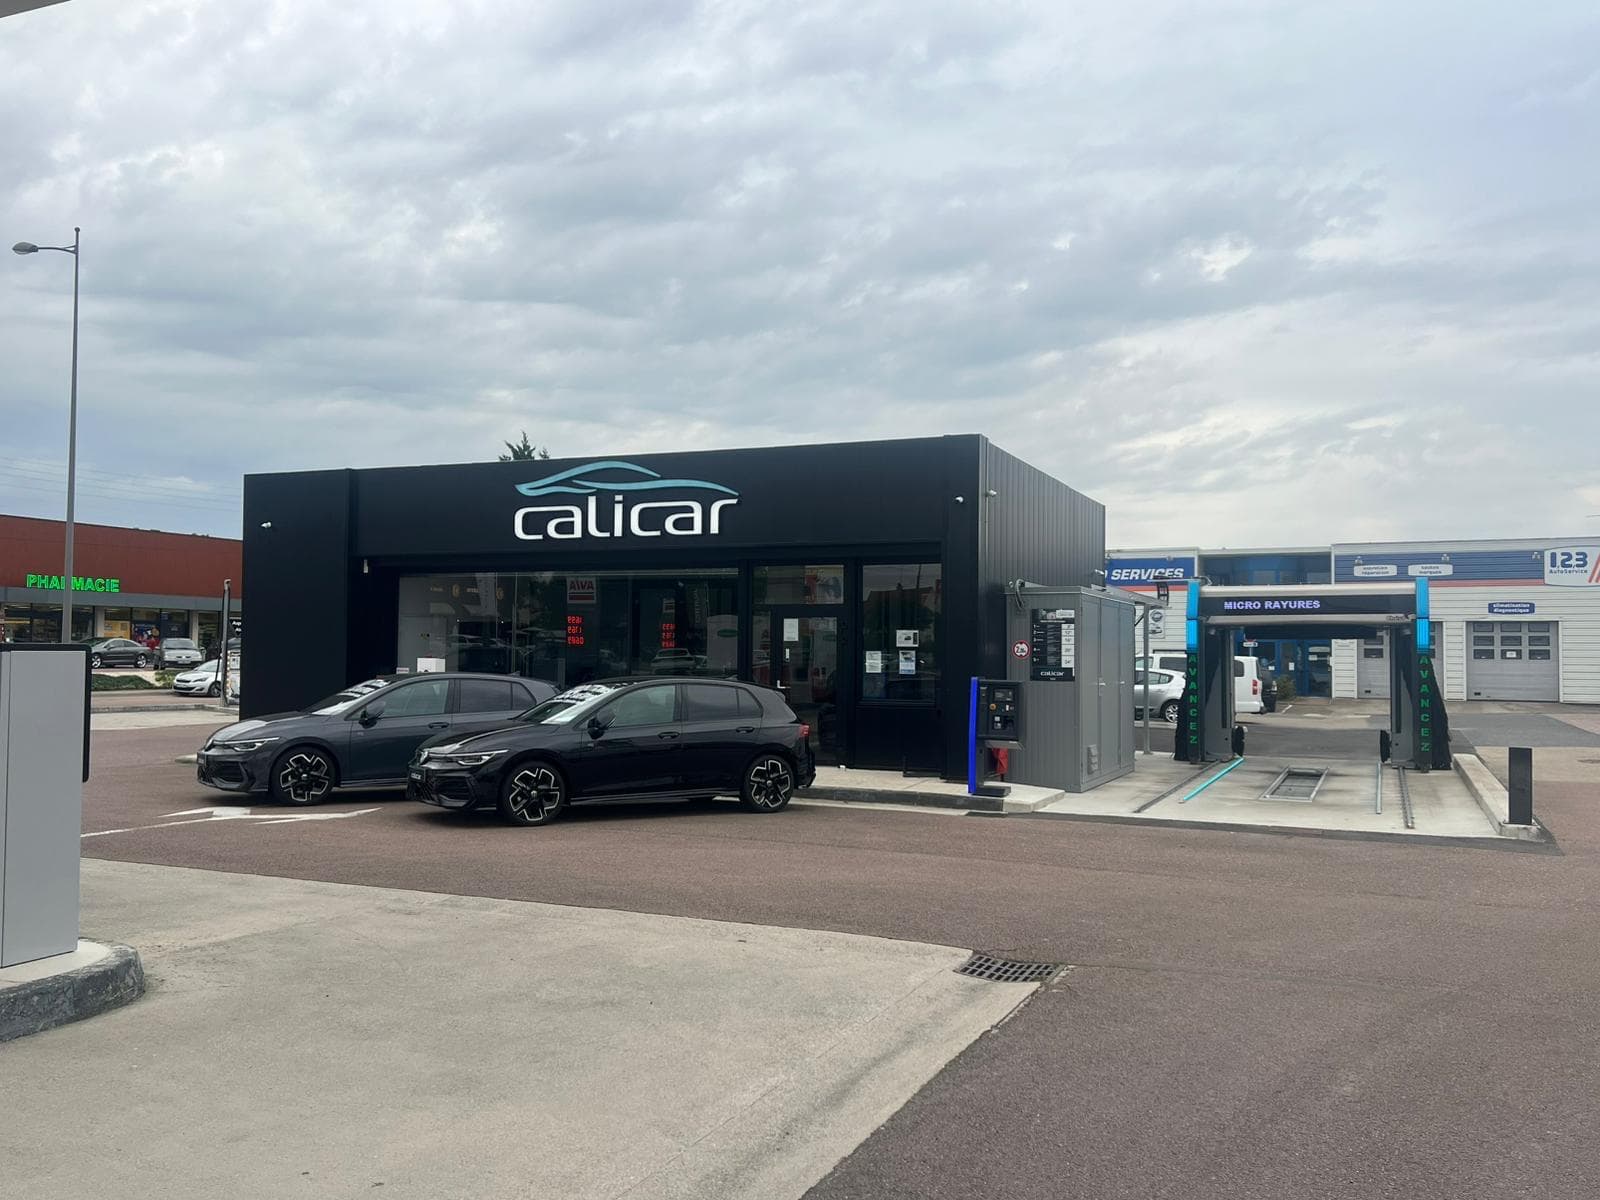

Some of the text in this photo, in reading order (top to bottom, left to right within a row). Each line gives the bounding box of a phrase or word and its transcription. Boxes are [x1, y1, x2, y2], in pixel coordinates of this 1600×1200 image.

[514, 494, 738, 540] calicar
[1111, 568, 1185, 581] SERVICES
[1223, 600, 1321, 610] MICRO RAYURES
